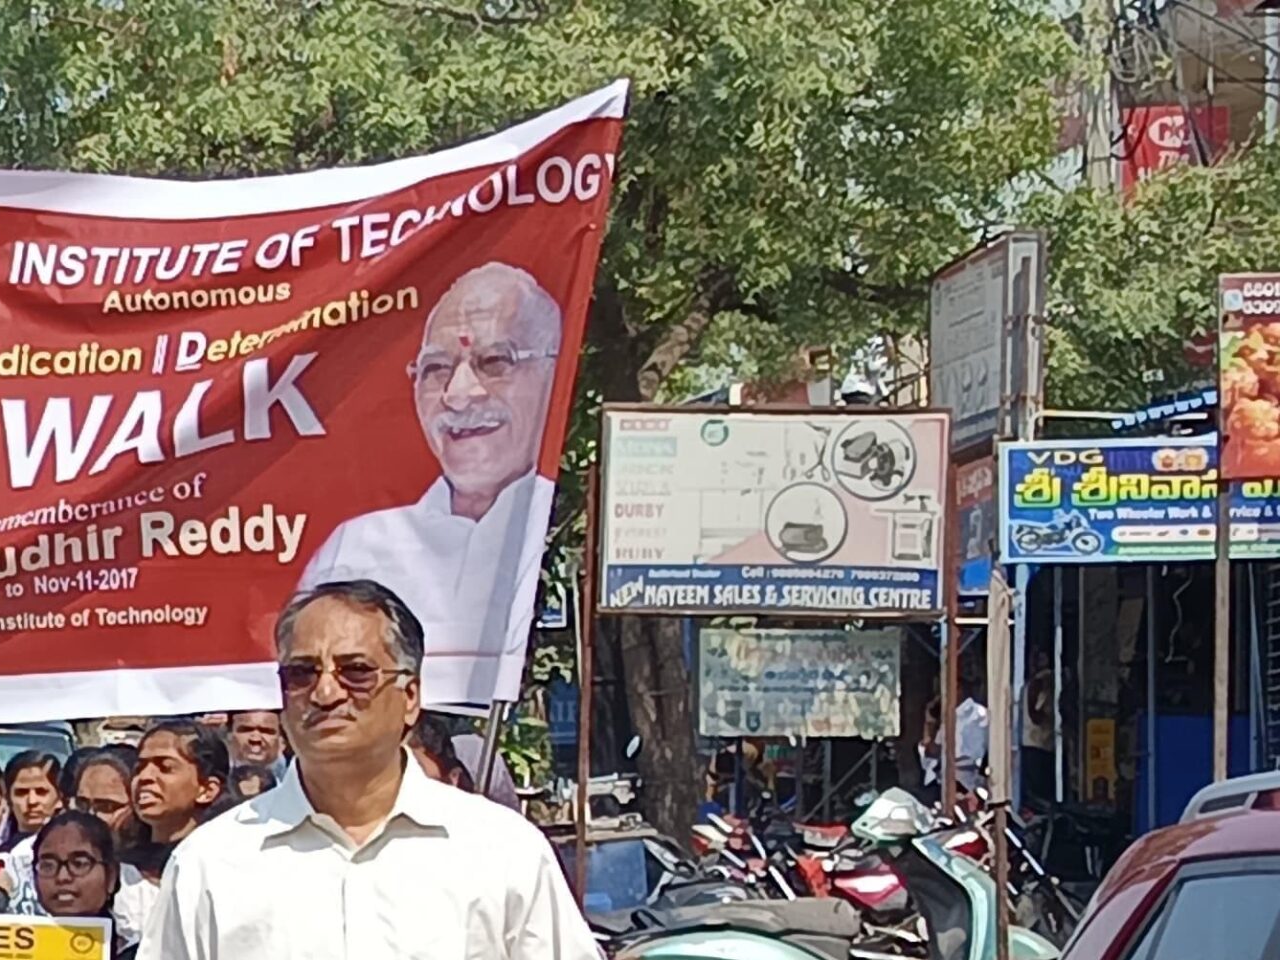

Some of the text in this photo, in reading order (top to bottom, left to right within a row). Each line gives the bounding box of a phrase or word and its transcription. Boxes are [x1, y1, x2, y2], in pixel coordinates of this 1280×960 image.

[9, 238, 248, 286] INSTITUTE
[255, 224, 320, 270] OF
[332, 153, 616, 263] TECOLOG
[102, 282, 291, 314] Autonomous
[0, 352, 327, 489] WALK
[1026, 448, 1104, 465] VDG
[173, 473, 207, 499] of
[140, 503, 308, 564] Reddy
[5, 582, 24, 599] to
[34, 567, 139, 595] Nov-11-2017
[609, 574, 933, 610] NEW NAYEEM SALES & SERVICING CENTRE
[71, 608, 91, 627] of
[95, 604, 208, 626] Technology
